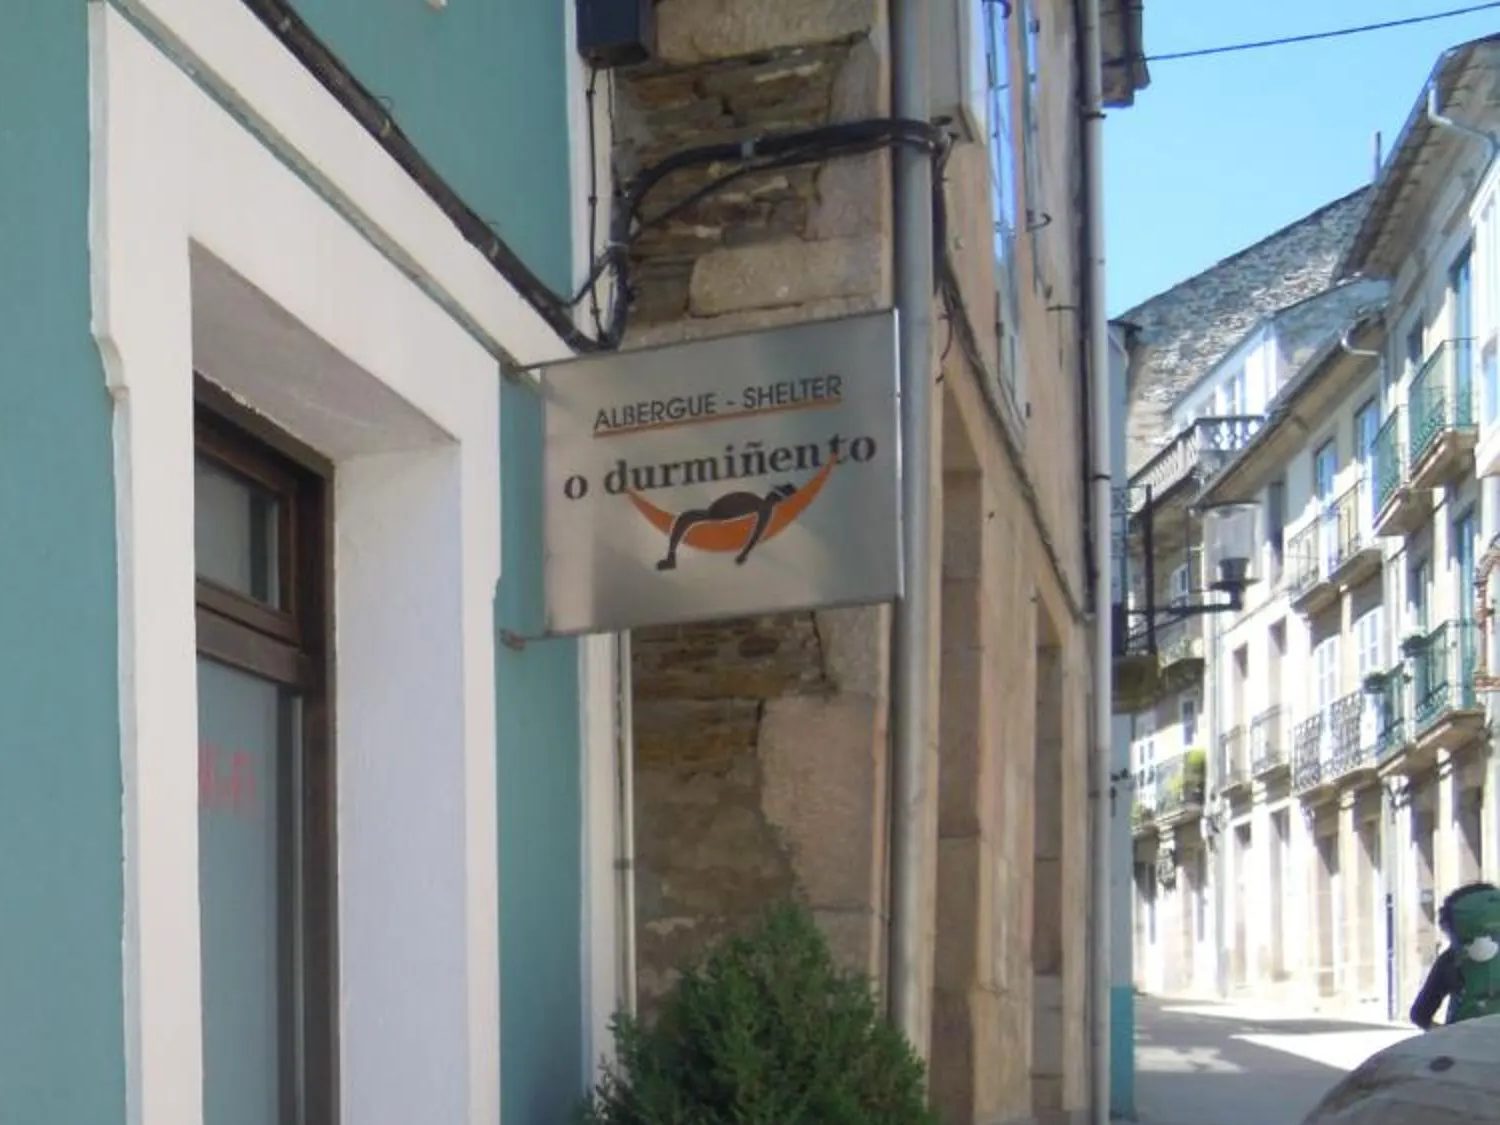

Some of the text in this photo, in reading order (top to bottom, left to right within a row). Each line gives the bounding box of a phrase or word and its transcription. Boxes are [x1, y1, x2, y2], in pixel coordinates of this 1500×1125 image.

[593, 392, 717, 430] ALBERGUE
[742, 374, 843, 410] SHELTER
[563, 433, 877, 500] o durmiñento
